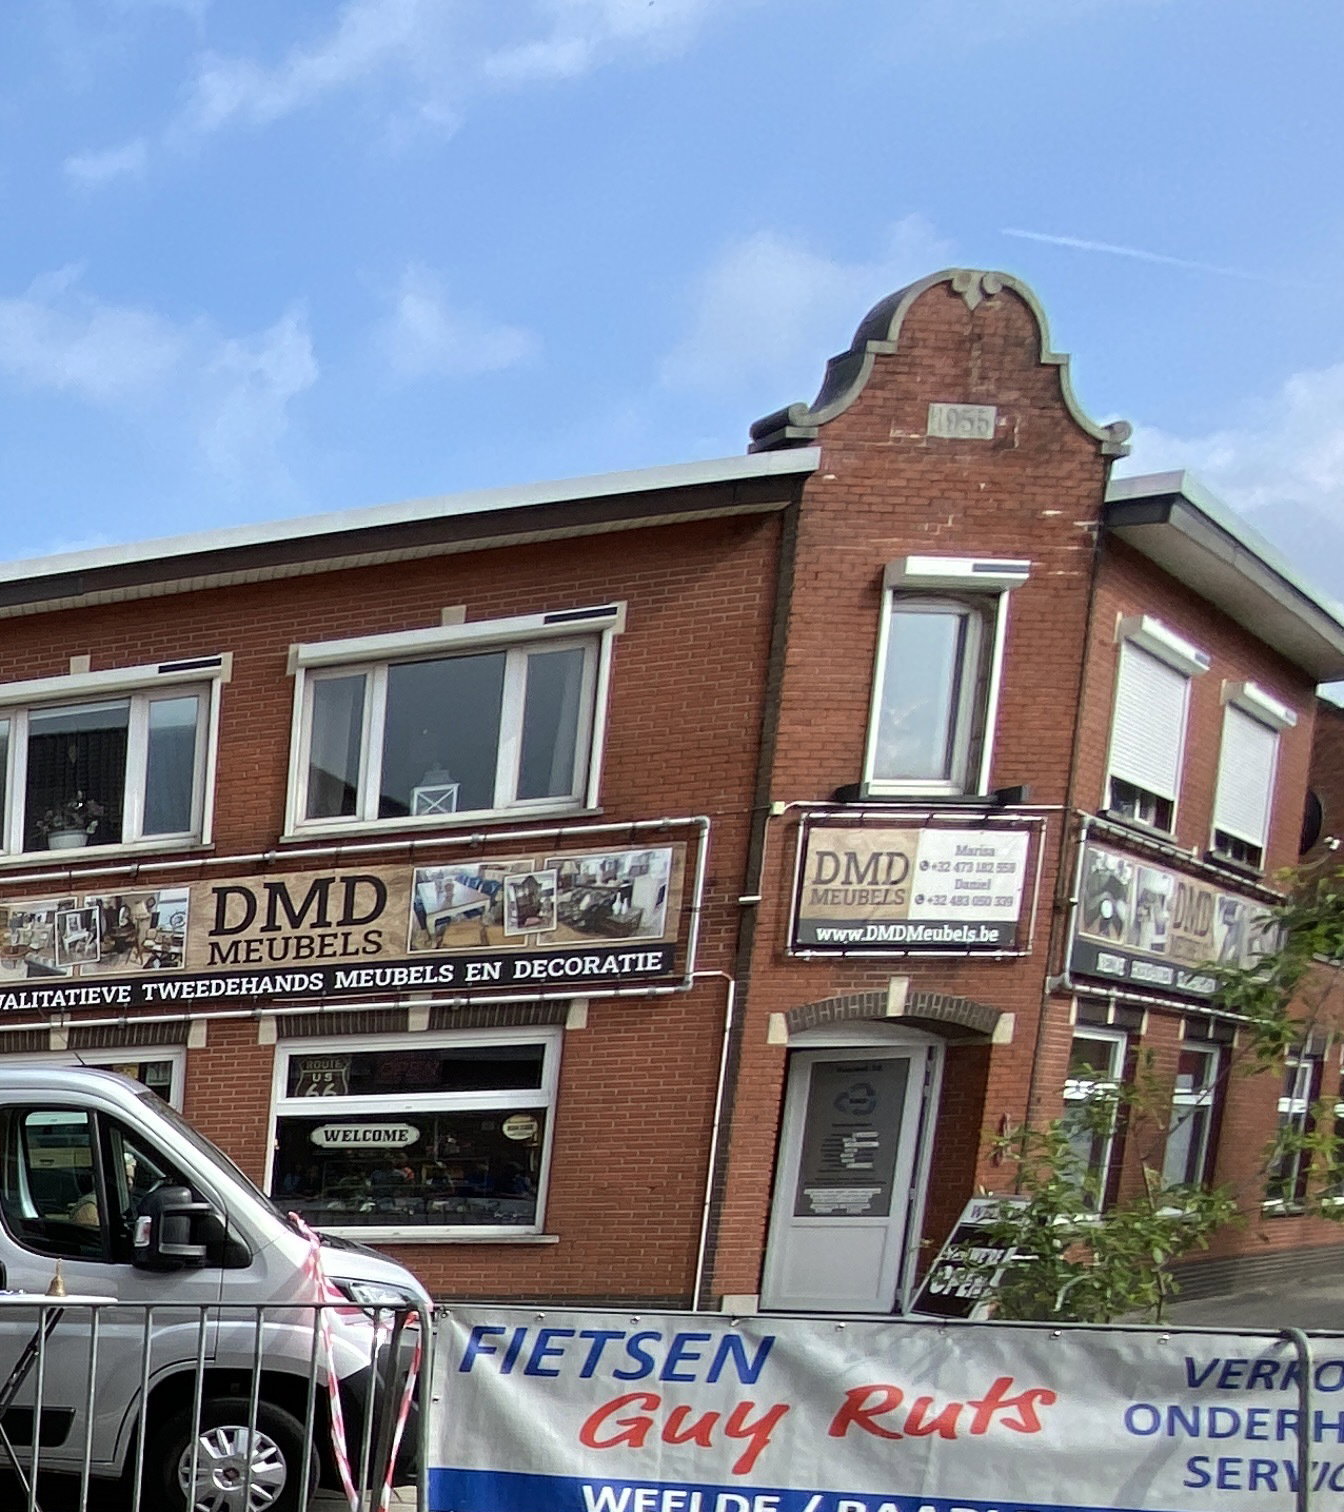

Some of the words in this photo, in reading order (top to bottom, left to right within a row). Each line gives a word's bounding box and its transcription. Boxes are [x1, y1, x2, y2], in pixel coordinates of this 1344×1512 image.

[813, 850, 909, 885] DMD
[209, 874, 388, 937] DMD
[809, 888, 906, 906] MEUBELS
[208, 930, 383, 966] MEUBELS
[816, 924, 1000, 943] www.DMDMeubels.be
[142, 973, 324, 999] TWEEDEHANDS
[335, 964, 454, 989] MEUBELS
[465, 961, 502, 982] EN
[513, 951, 664, 980] DECORATIE
[324, 1129, 409, 1142] WELCOME
[459, 1325, 776, 1385] FIETSEN
[580, 1392, 790, 1475] Guy
[828, 1377, 1057, 1440] Ruts
